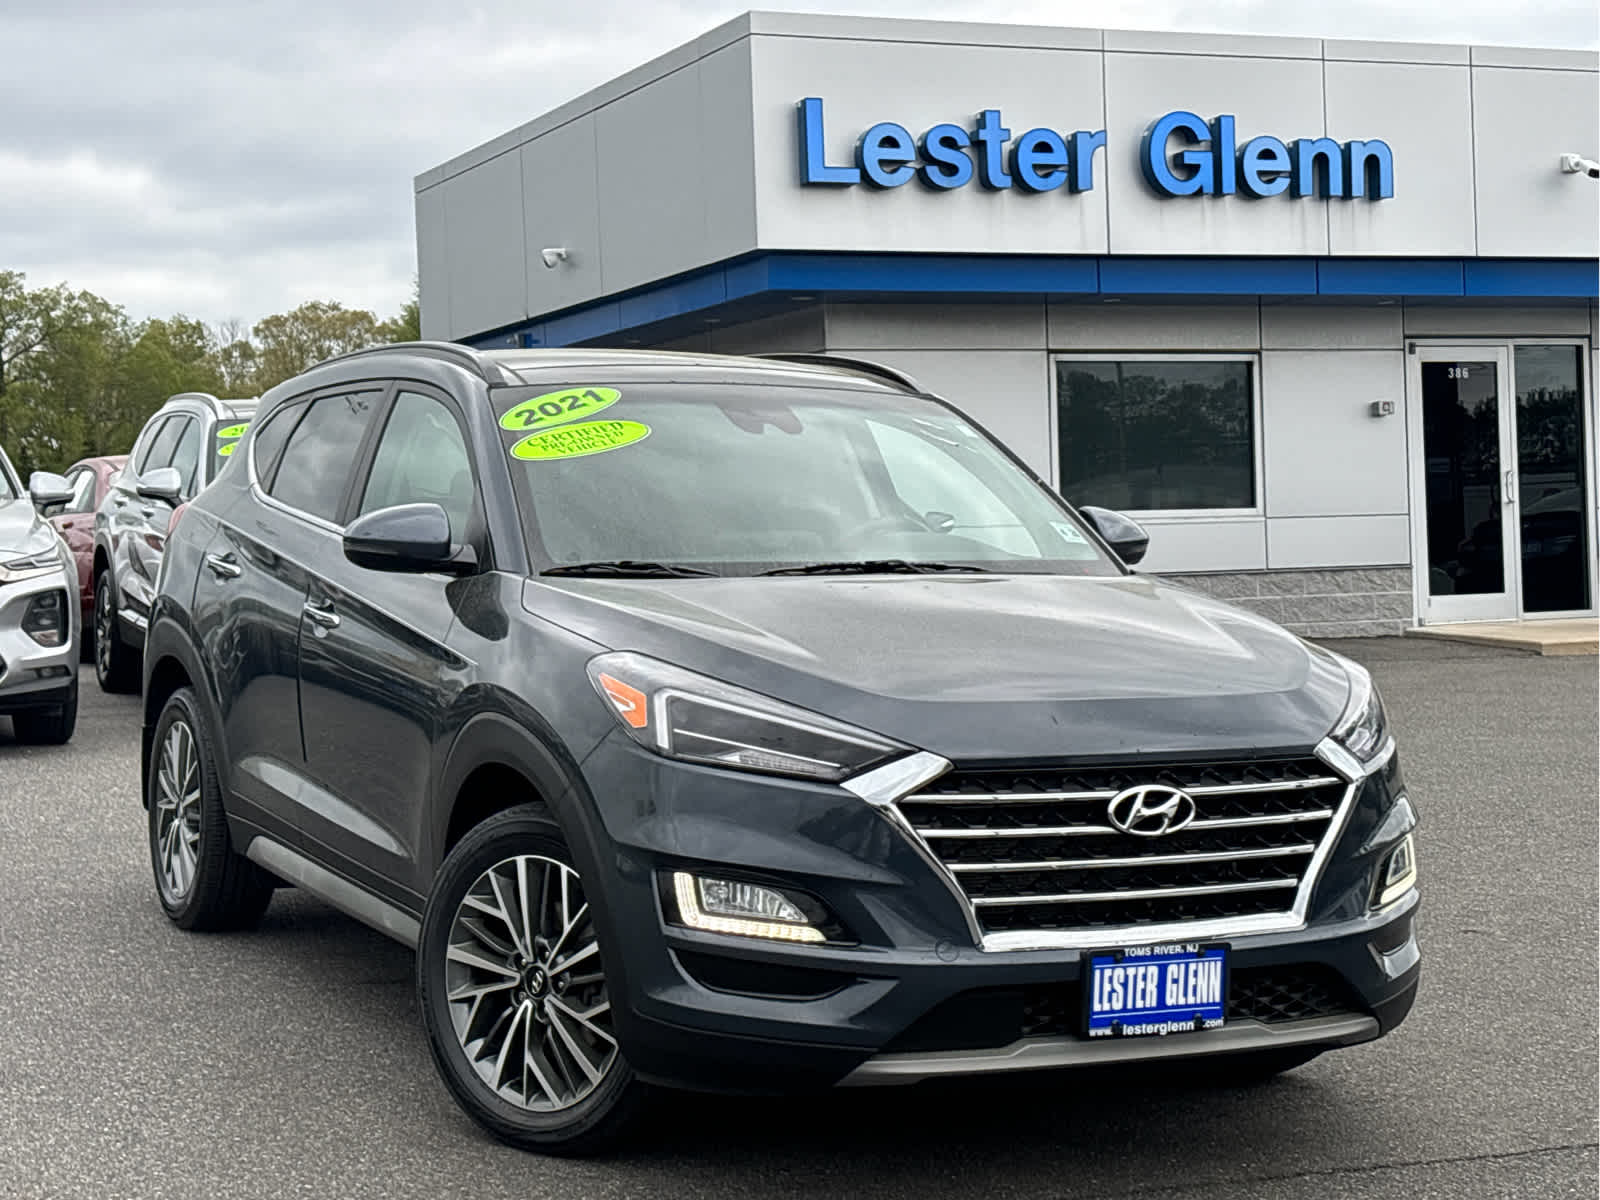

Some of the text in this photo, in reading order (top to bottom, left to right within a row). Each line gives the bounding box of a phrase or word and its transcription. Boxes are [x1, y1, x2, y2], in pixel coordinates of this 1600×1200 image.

[797, 97, 1394, 199] Lester Glenn
[1448, 367, 1469, 379] 386
[514, 389, 606, 427] 2021
[527, 421, 624, 447] CERTIFIED
[1124, 946, 1151, 957] TOMS
[1187, 943, 1199, 953] NJ
[1093, 960, 1222, 1012] LESTER GLENN
[1122, 1020, 1195, 1036] lesterglenn
